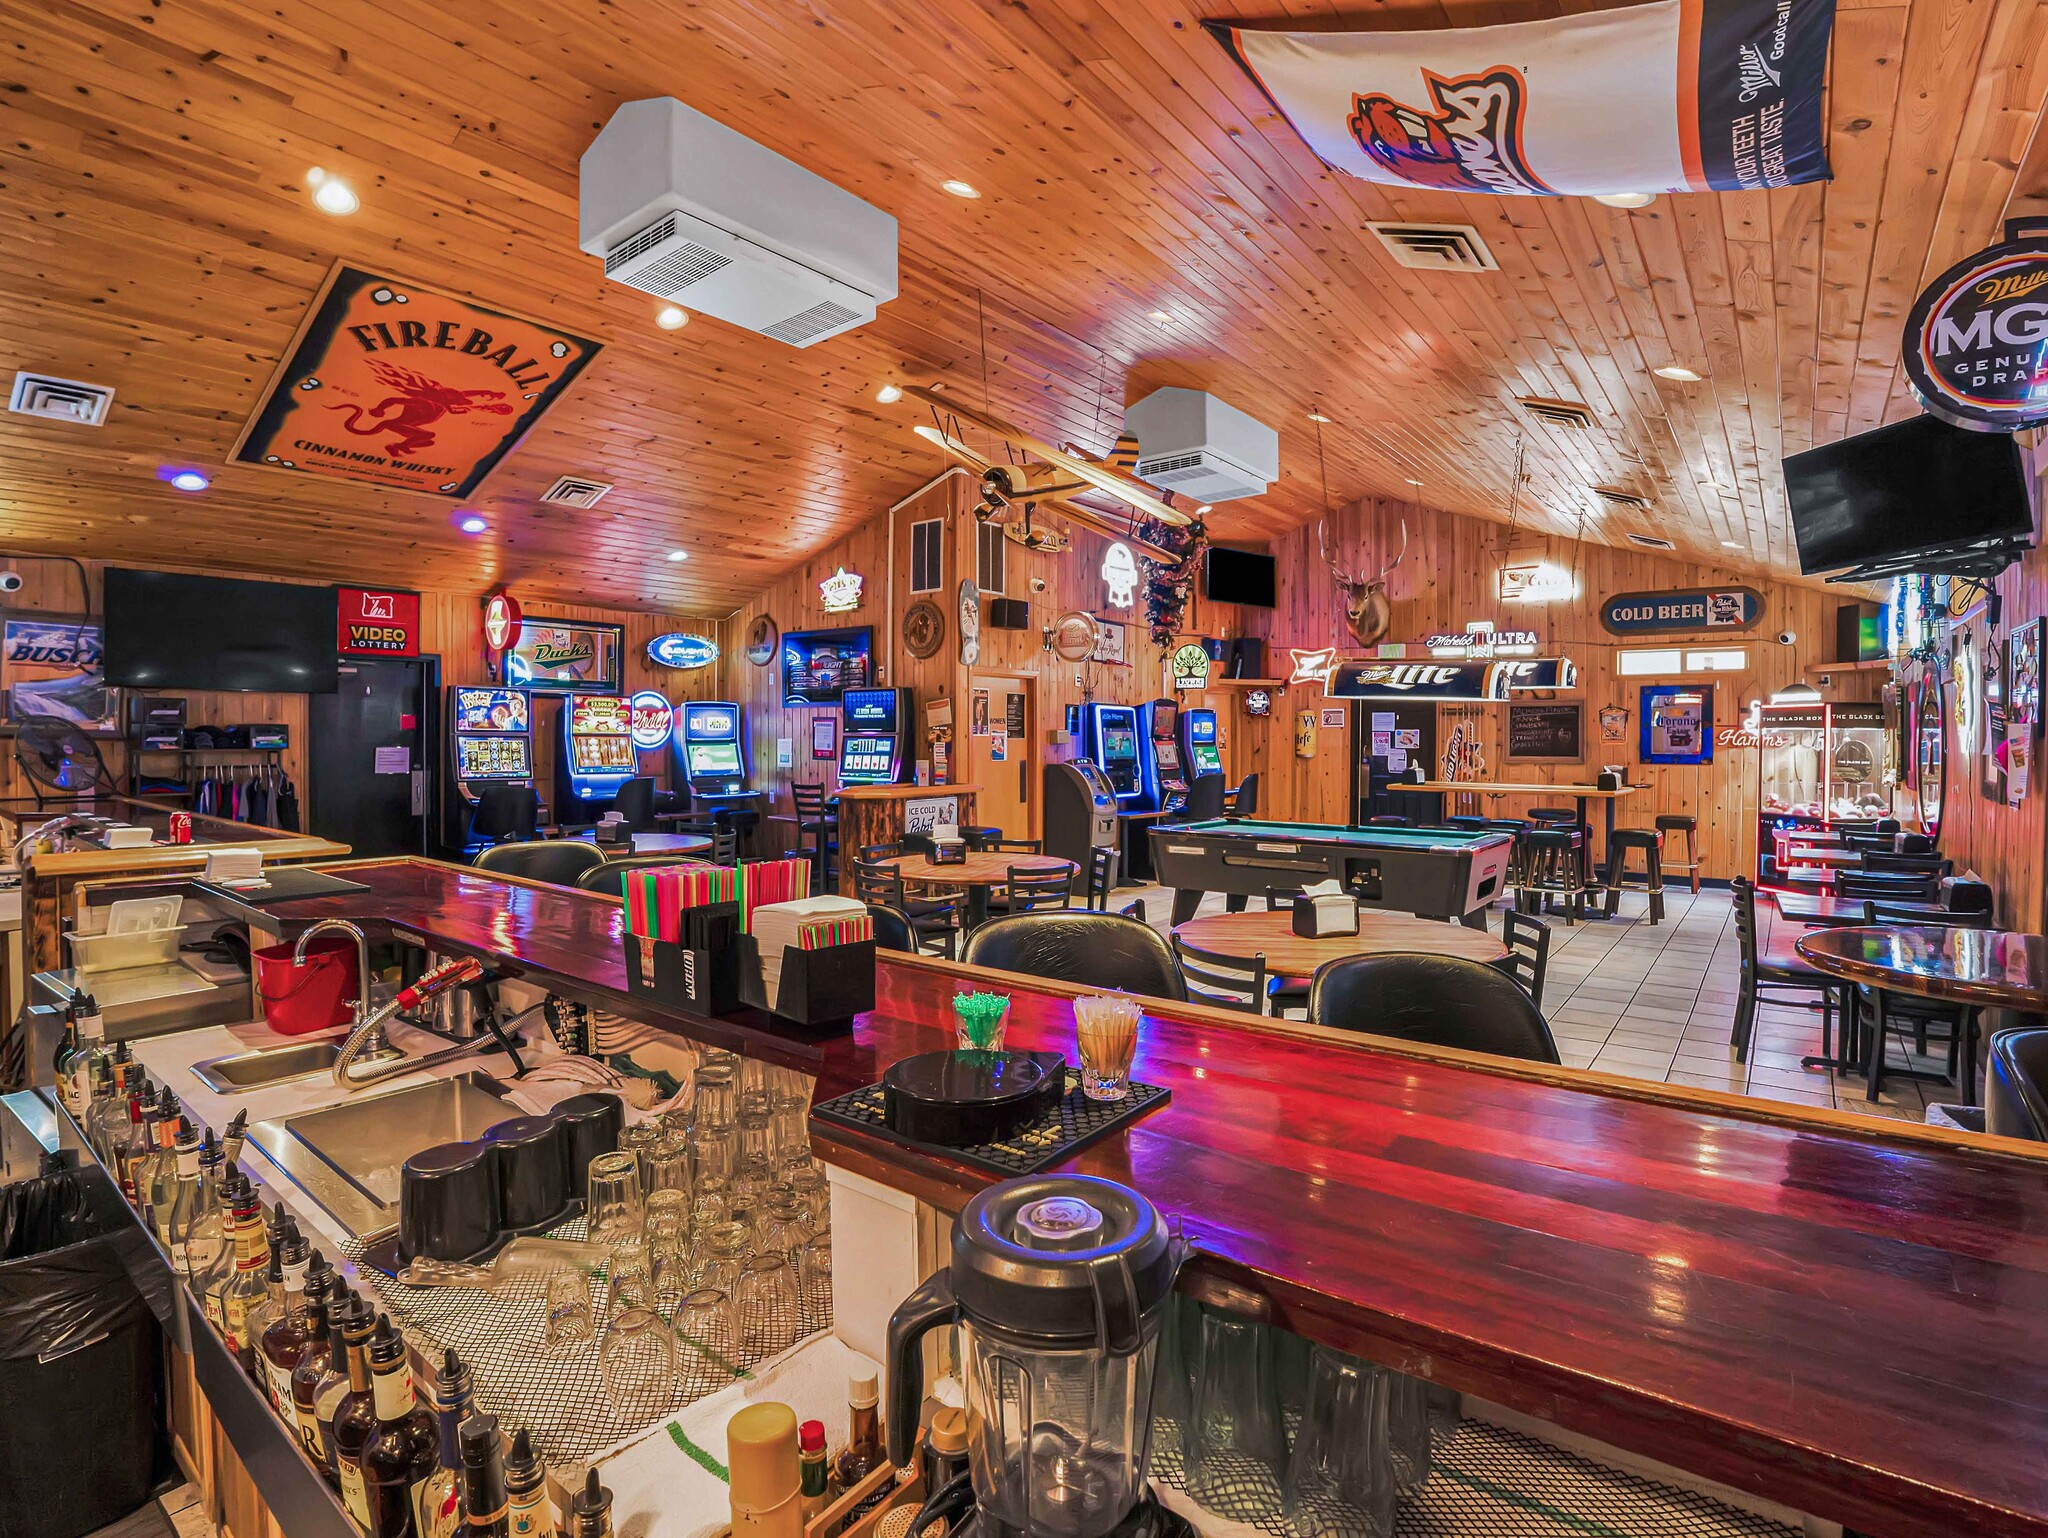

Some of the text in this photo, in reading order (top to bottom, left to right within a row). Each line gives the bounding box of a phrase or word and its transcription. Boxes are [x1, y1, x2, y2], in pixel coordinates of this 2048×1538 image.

[1738, 44, 1774, 103] Miller
[1731, 113, 1756, 157] TEETH
[347, 319, 551, 391] FIREBALL
[294, 439, 457, 476] CINNAMON WHISKY
[1611, 603, 1705, 622] COLD BEER
[350, 625, 406, 642] VIDEO
[1426, 631, 1538, 648] Michelob ULTRA
[351, 639, 405, 650] LOTTERY
[534, 642, 593, 661] Ducks
[1383, 664, 1462, 690] Lite
[908, 805, 936, 816] ICE COLD
[909, 815, 935, 833] Pabst
